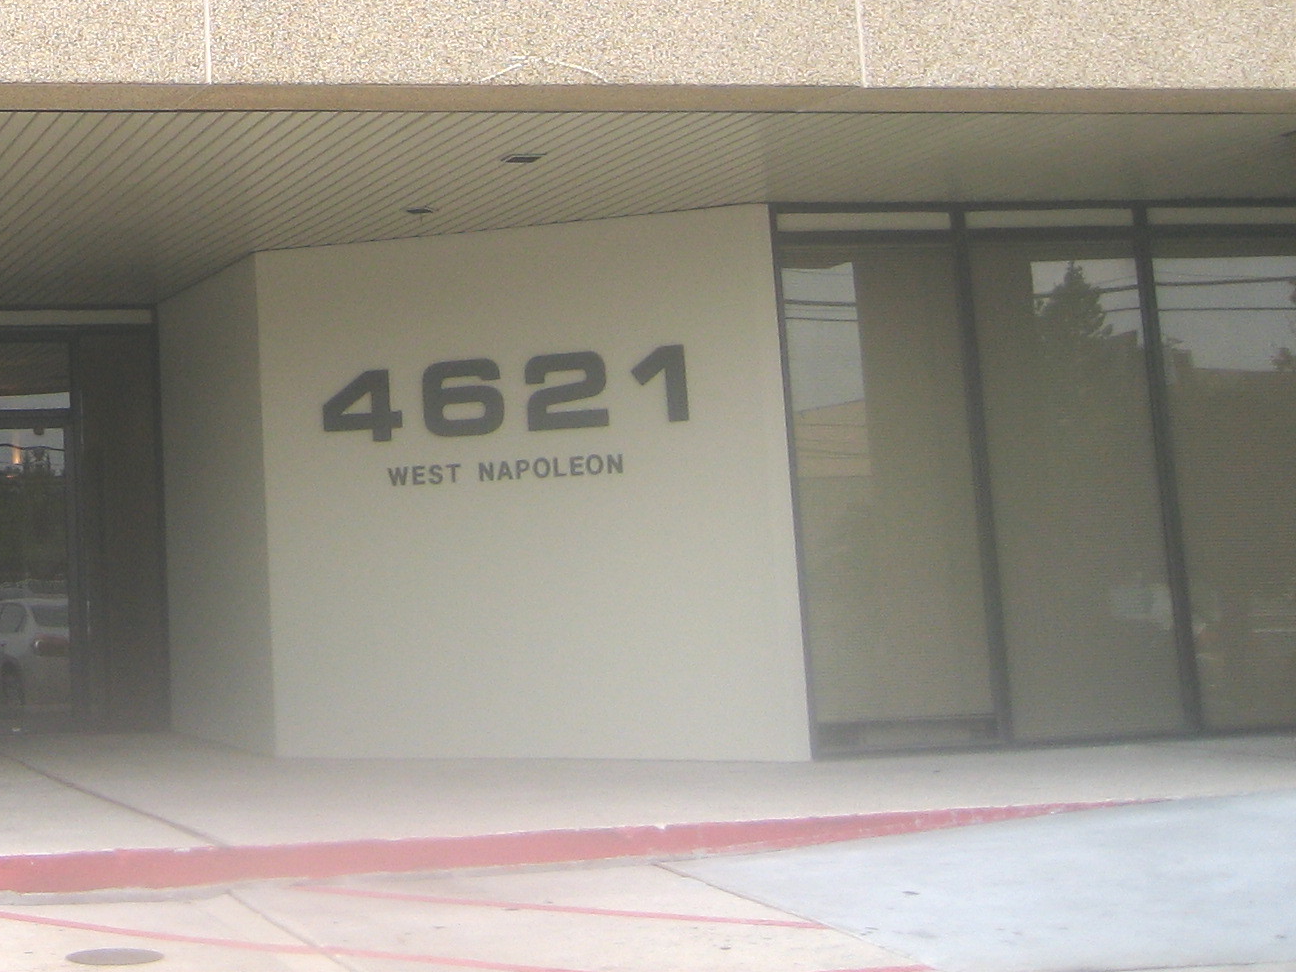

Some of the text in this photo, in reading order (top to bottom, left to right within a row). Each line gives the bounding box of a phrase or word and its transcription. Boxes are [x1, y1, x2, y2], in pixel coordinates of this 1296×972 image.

[322, 344, 690, 442] 4621
[388, 453, 624, 486] WEST NAPOLEON
